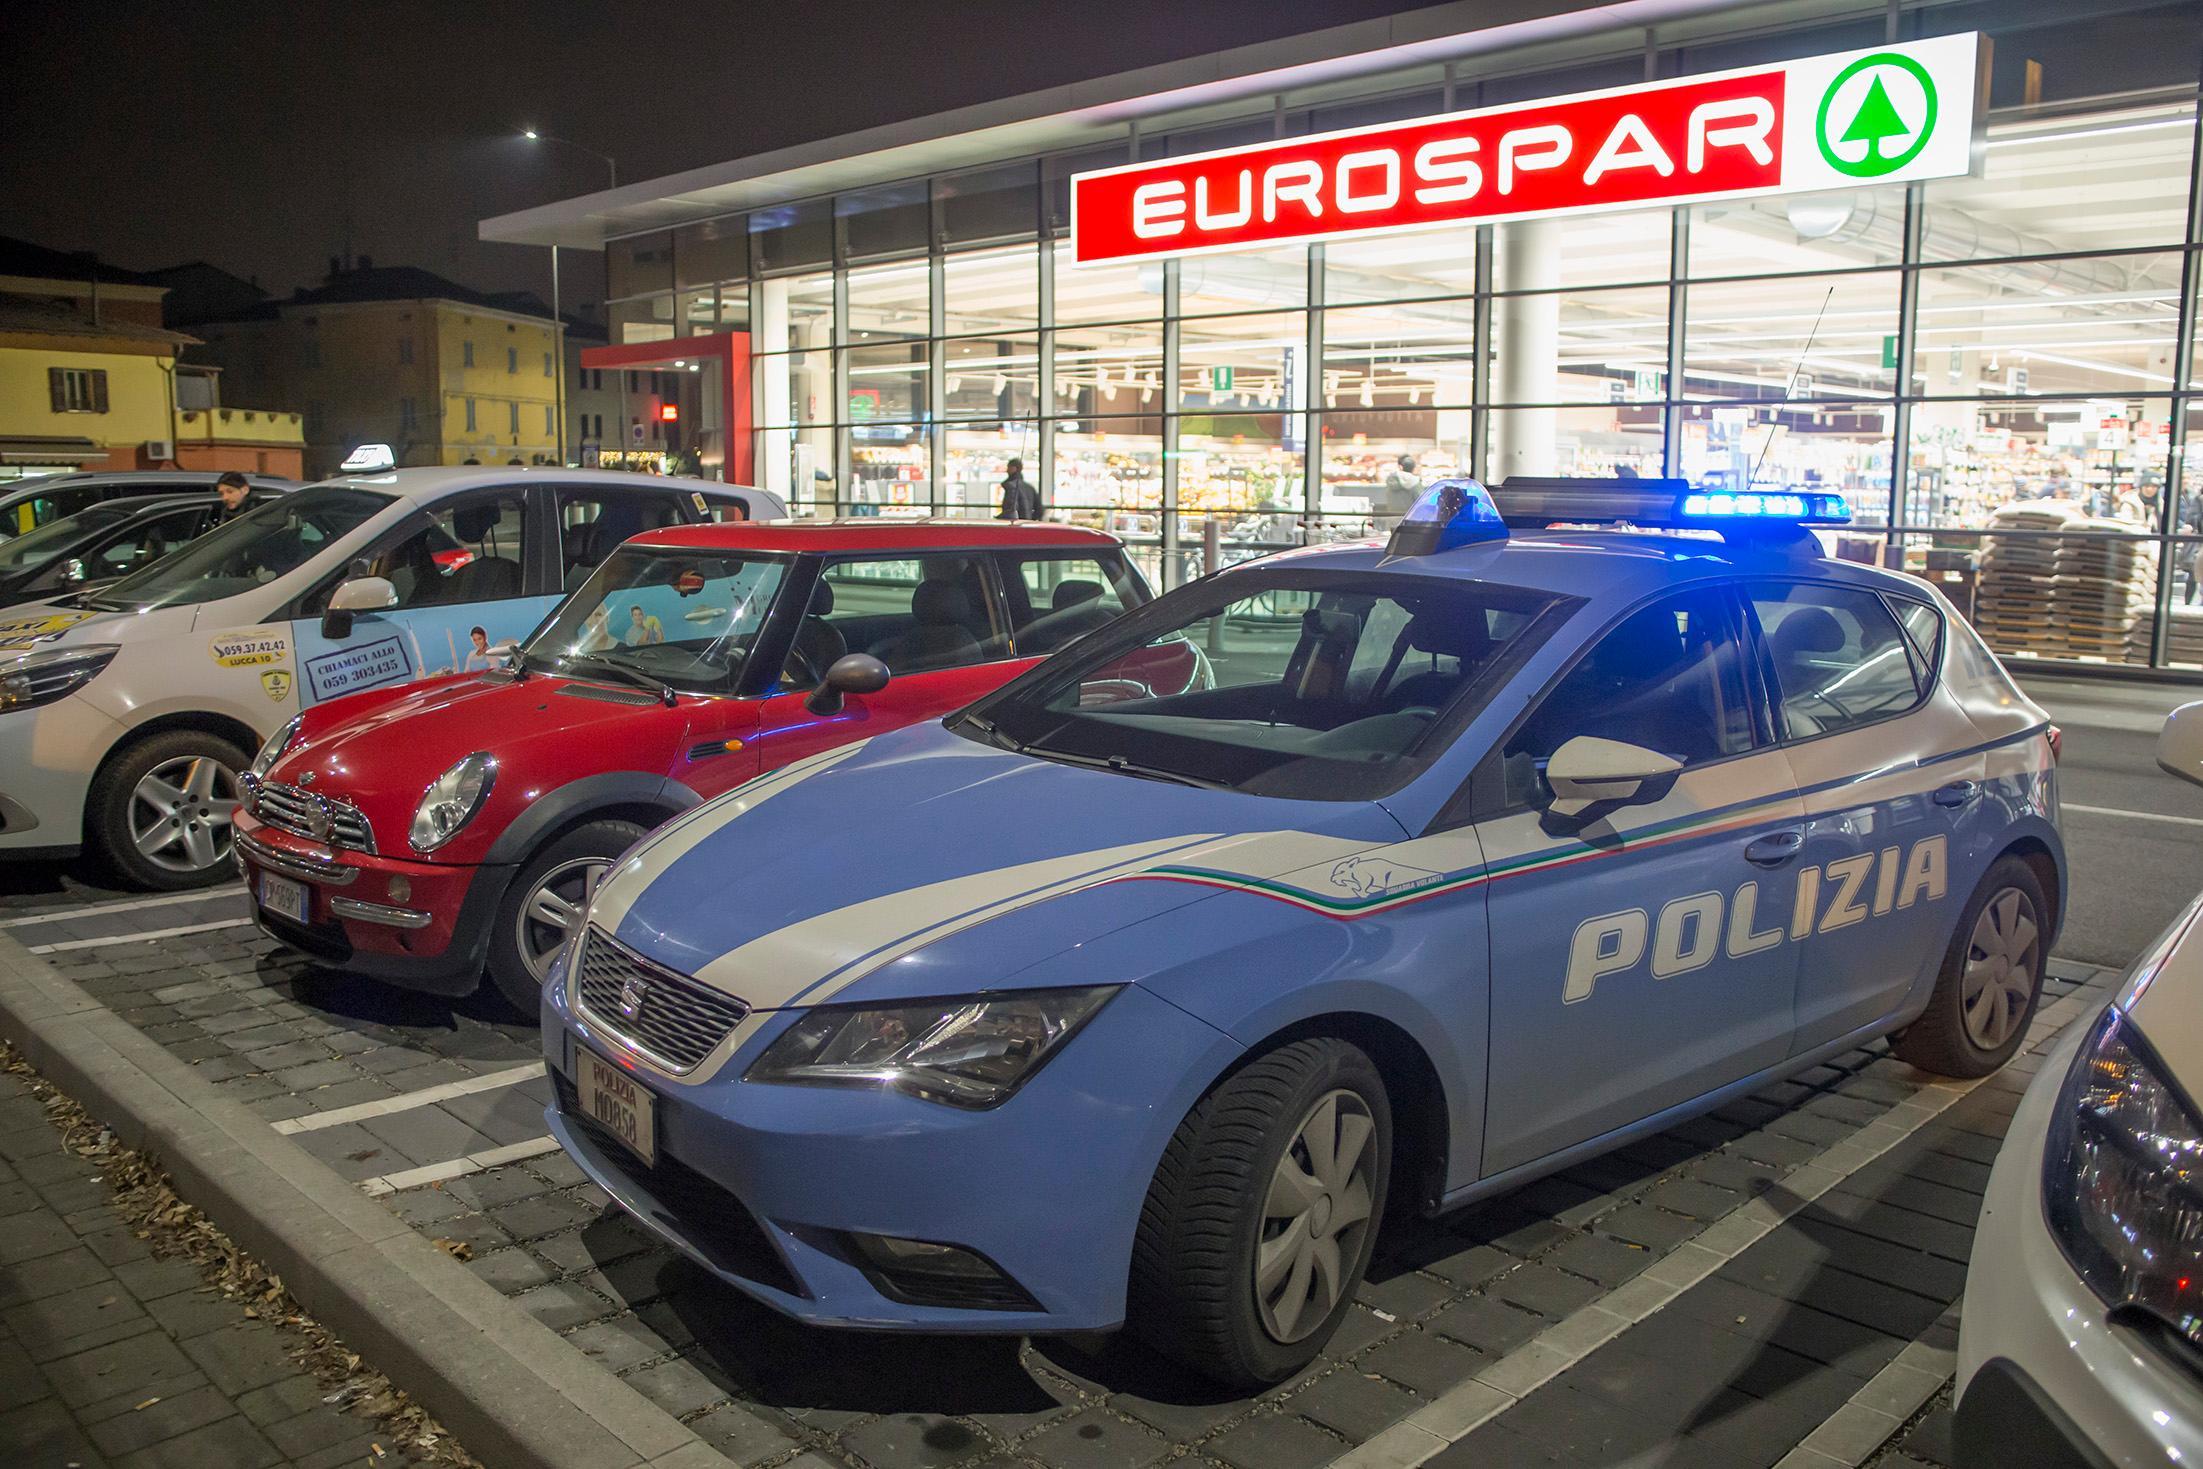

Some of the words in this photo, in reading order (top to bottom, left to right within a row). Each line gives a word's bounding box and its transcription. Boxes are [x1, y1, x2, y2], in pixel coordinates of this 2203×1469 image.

[1132, 95, 1775, 240] EUROSPAR
[223, 640, 286, 656] 059.37.42.42
[229, 656, 258, 666] LUCCA
[260, 655, 272, 663] 10
[317, 653, 369, 676] CHIAMACI
[370, 646, 396, 661] ALLO
[322, 673, 349, 690] 059
[351, 659, 399, 682] 303435
[1561, 832, 1948, 1006] POLIZIA
[593, 1061, 637, 1110] POLIZIA
